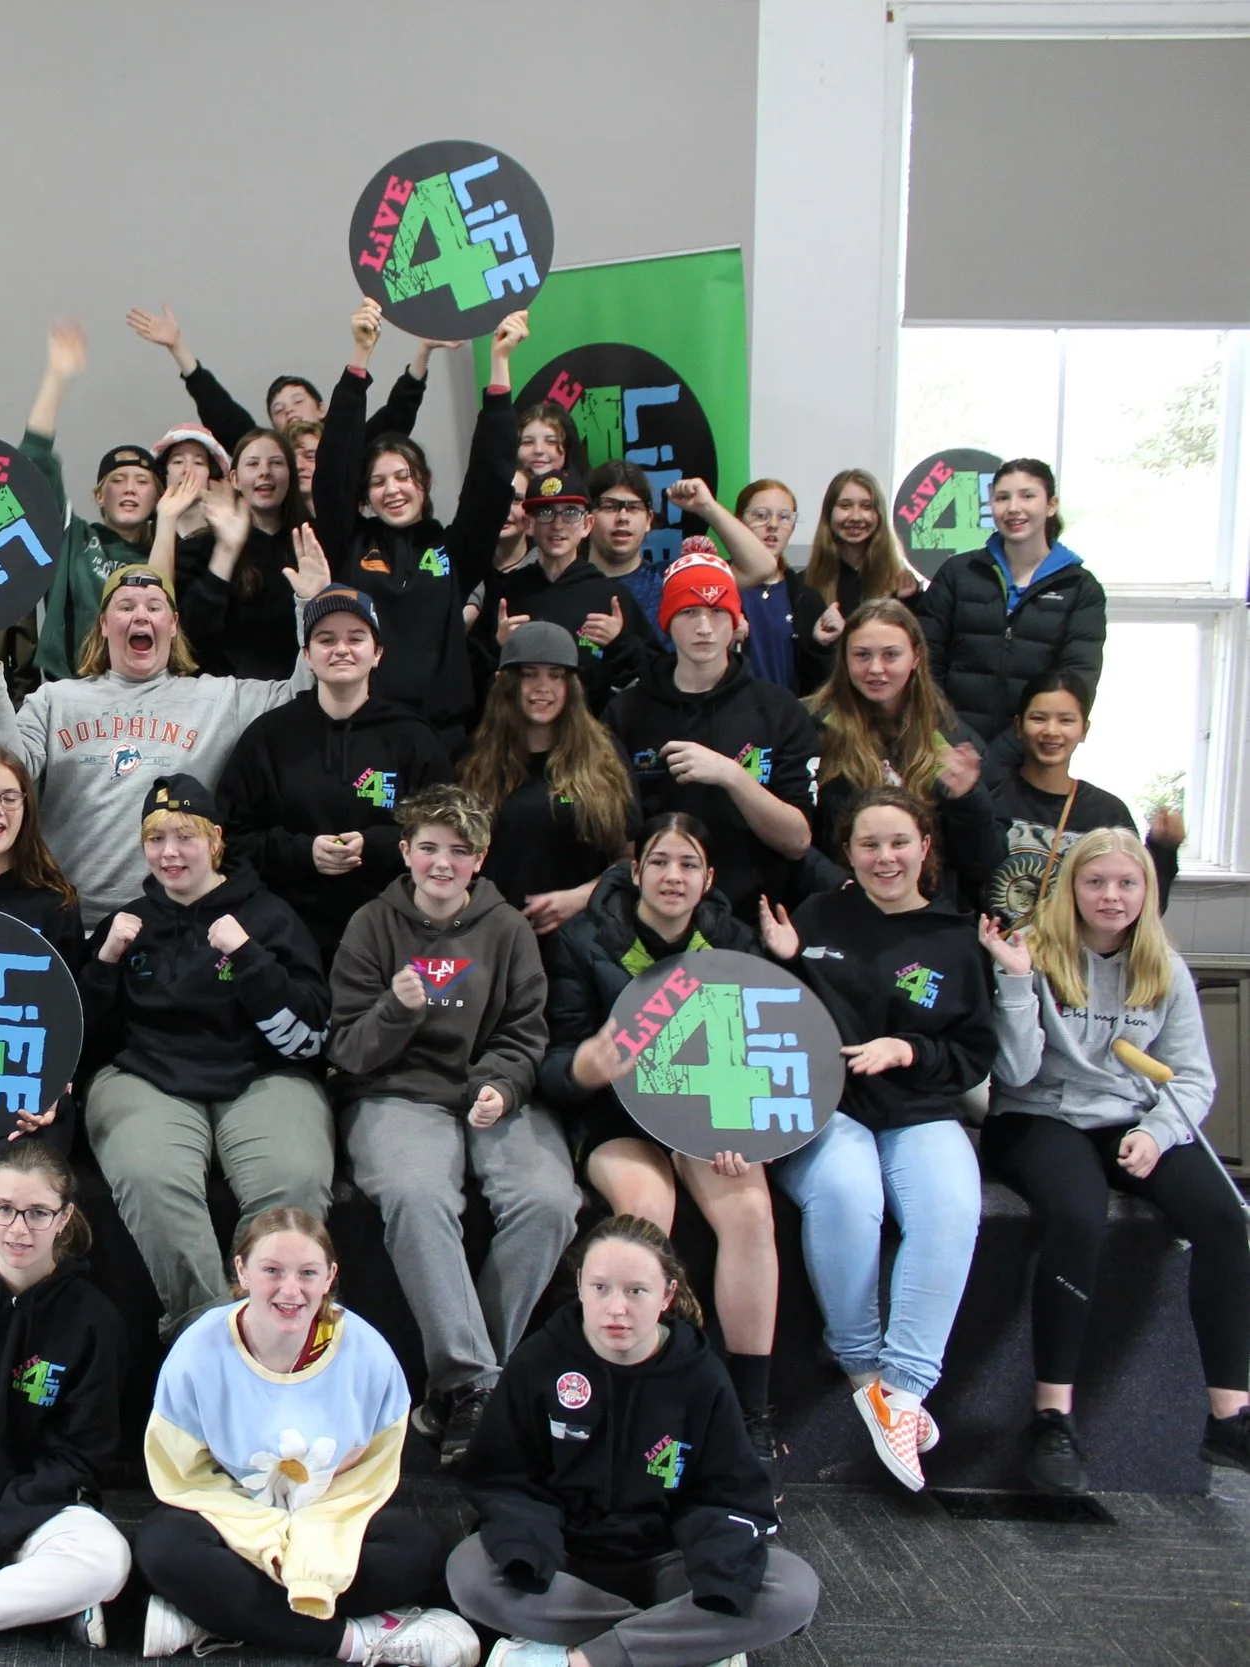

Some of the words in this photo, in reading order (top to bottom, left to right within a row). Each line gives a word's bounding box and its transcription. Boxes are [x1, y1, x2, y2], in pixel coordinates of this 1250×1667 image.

[359, 174, 414, 273] LiVE
[382, 171, 500, 311] 4
[449, 156, 540, 300] LiFE
[898, 460, 954, 525] LiVE
[910, 471, 998, 554] 4
[419, 548, 444, 577] 4
[56, 716, 199, 752] DOLPHINS
[357, 771, 388, 806] 4
[740, 747, 764, 780] 4
[427, 997, 464, 1008] LUB
[615, 967, 703, 1056] LiVE
[896, 967, 931, 1003] 4
[637, 984, 771, 1130] 4
[742, 987, 814, 1133] LiFE
[12, 1360, 50, 1404] 4
[646, 1440, 679, 1488] 4
